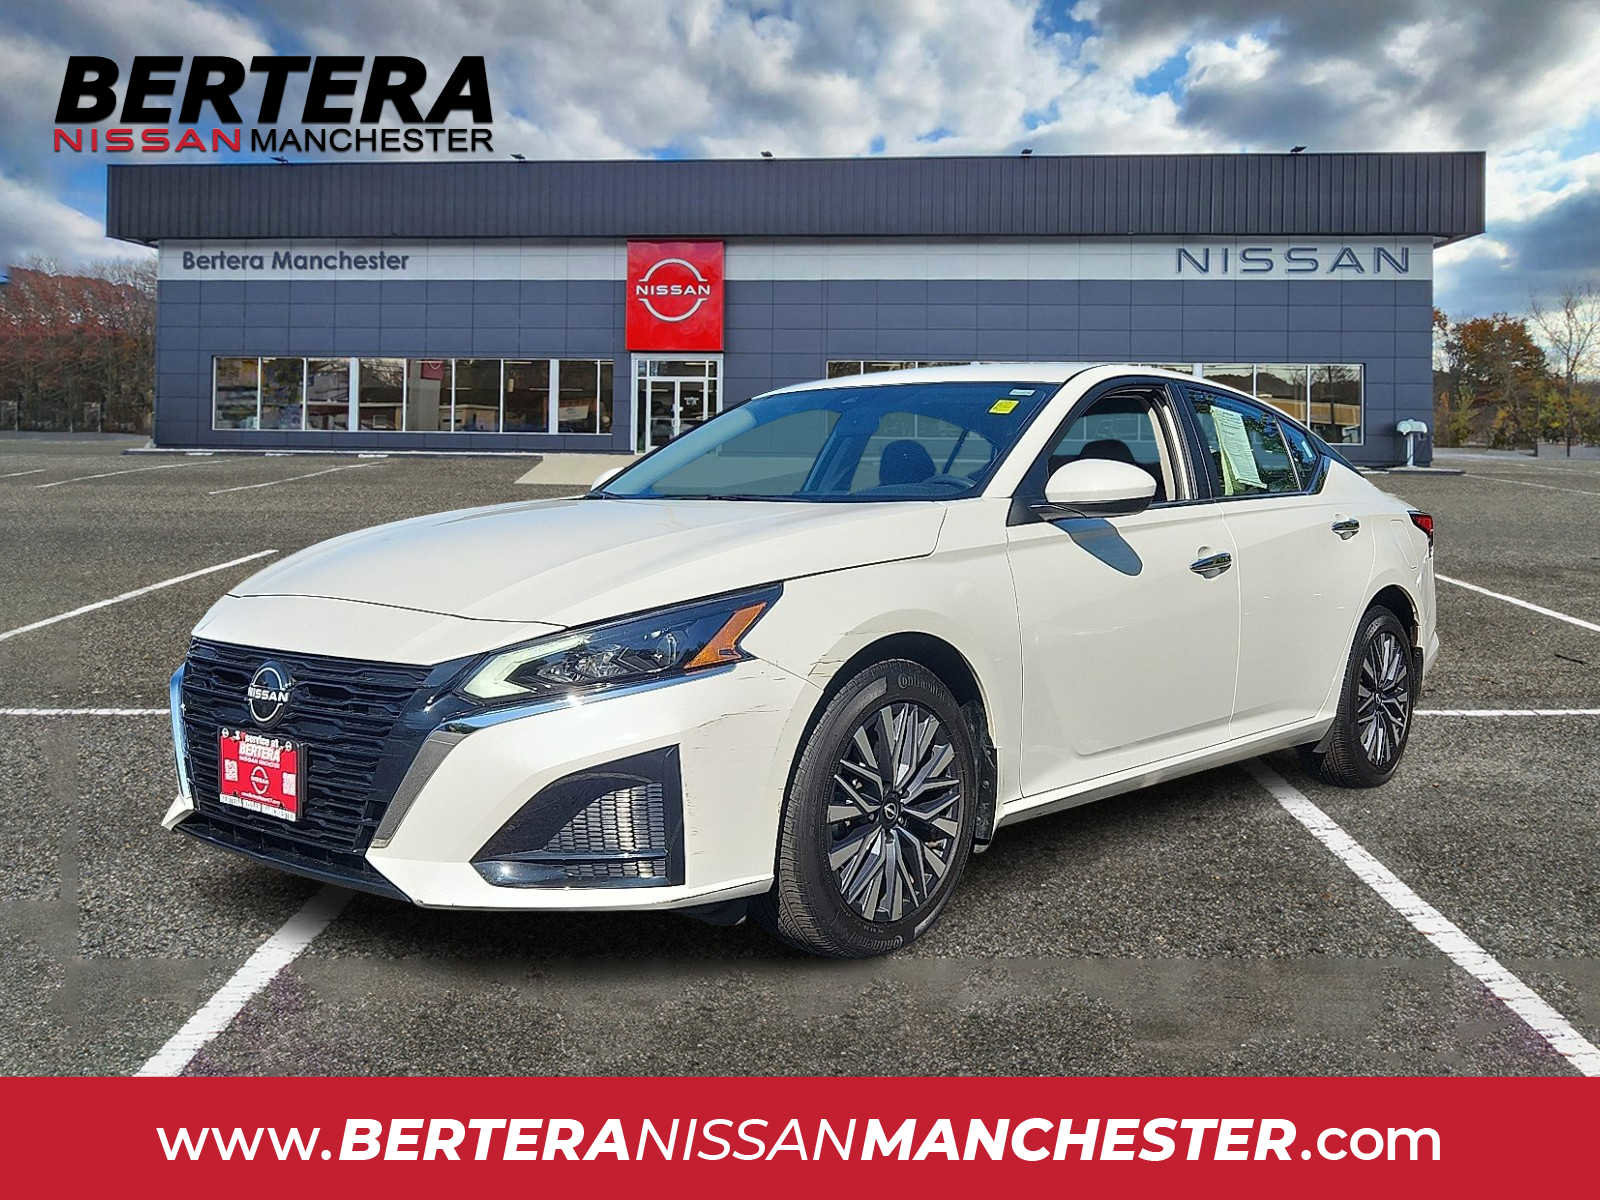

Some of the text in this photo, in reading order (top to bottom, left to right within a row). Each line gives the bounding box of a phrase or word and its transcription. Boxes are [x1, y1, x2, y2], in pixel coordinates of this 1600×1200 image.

[182, 250, 409, 270] Bertera Manchester
[1177, 247, 1409, 273] NISSAN
[636, 285, 710, 295] NISSAN
[248, 686, 289, 702] NISSAN
